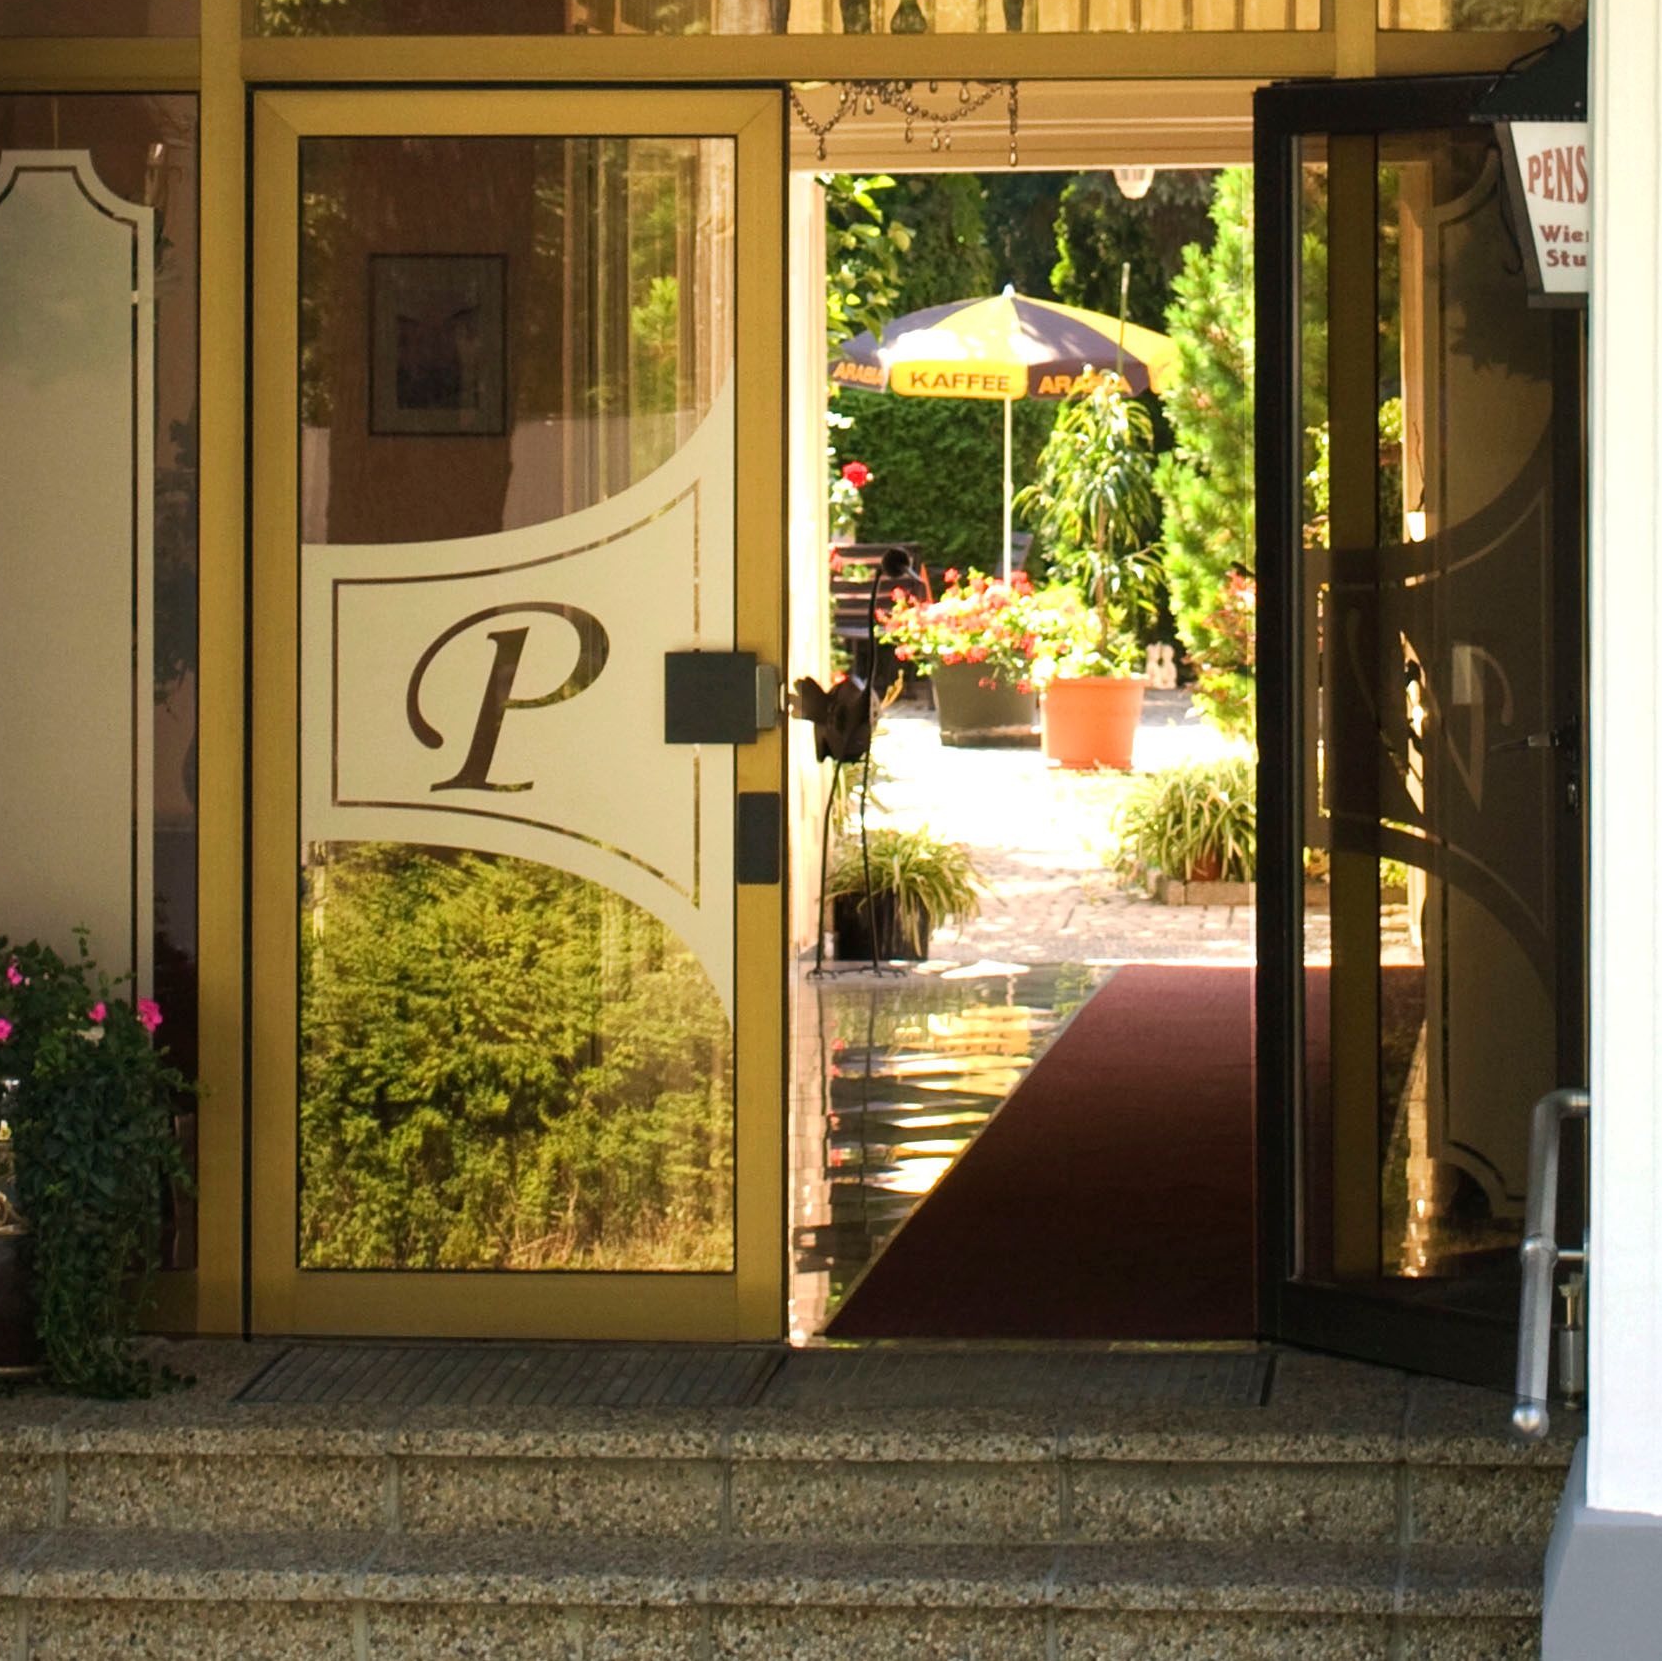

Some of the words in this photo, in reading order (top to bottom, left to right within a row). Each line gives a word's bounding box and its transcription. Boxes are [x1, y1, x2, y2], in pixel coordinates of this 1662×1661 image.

[1527, 145, 1588, 204] PENS
[1546, 249, 1587, 267] Stu
[910, 371, 1010, 392] KAFFEE
[406, 601, 610, 792] P
